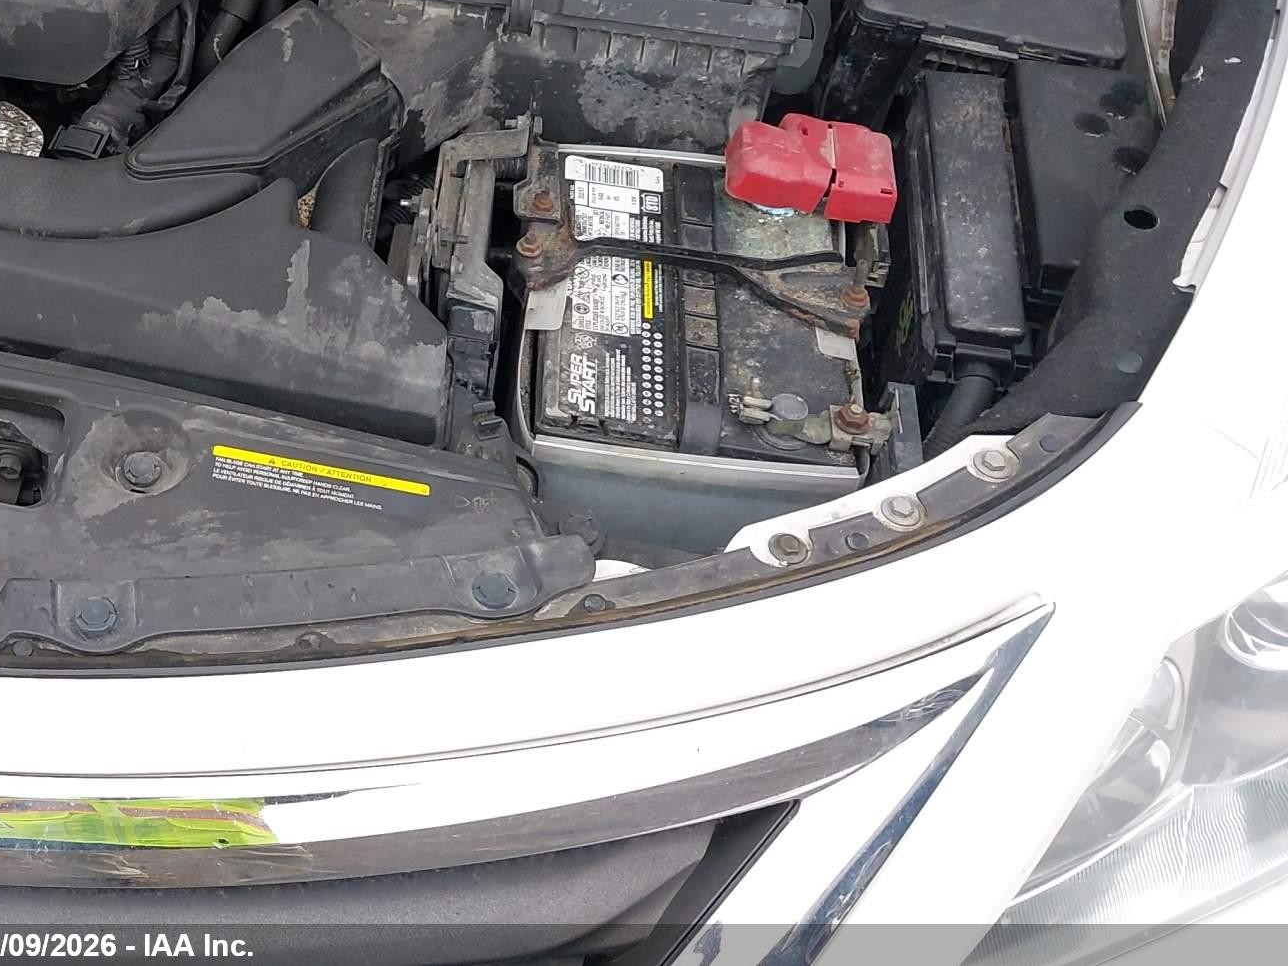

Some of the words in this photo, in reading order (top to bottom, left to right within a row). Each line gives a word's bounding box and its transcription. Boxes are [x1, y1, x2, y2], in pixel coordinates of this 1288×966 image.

[568, 353, 582, 405] SUPER
[580, 355, 596, 414] START
[281, 461, 318, 472] CAUTION
[326, 470, 372, 482] ATTENTION
